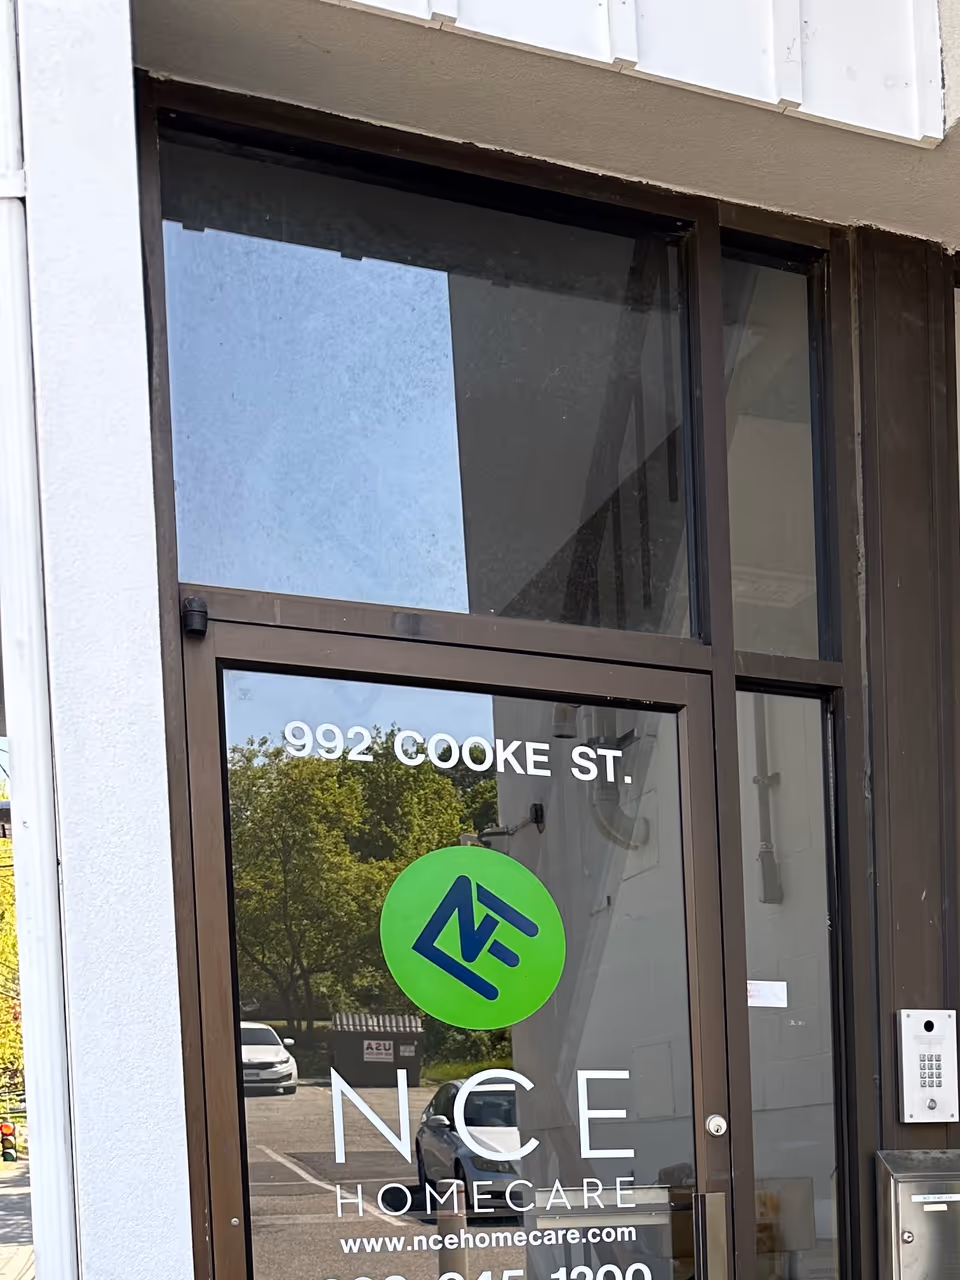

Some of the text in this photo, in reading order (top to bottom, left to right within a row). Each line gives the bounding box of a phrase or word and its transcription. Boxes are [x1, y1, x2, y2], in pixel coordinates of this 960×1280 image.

[284, 721, 632, 784] 992 COOKE ST.
[330, 1067, 635, 1164] NCE
[336, 1177, 637, 1218] HOMECARE
[340, 1225, 637, 1254] www.ncehomecare.com
